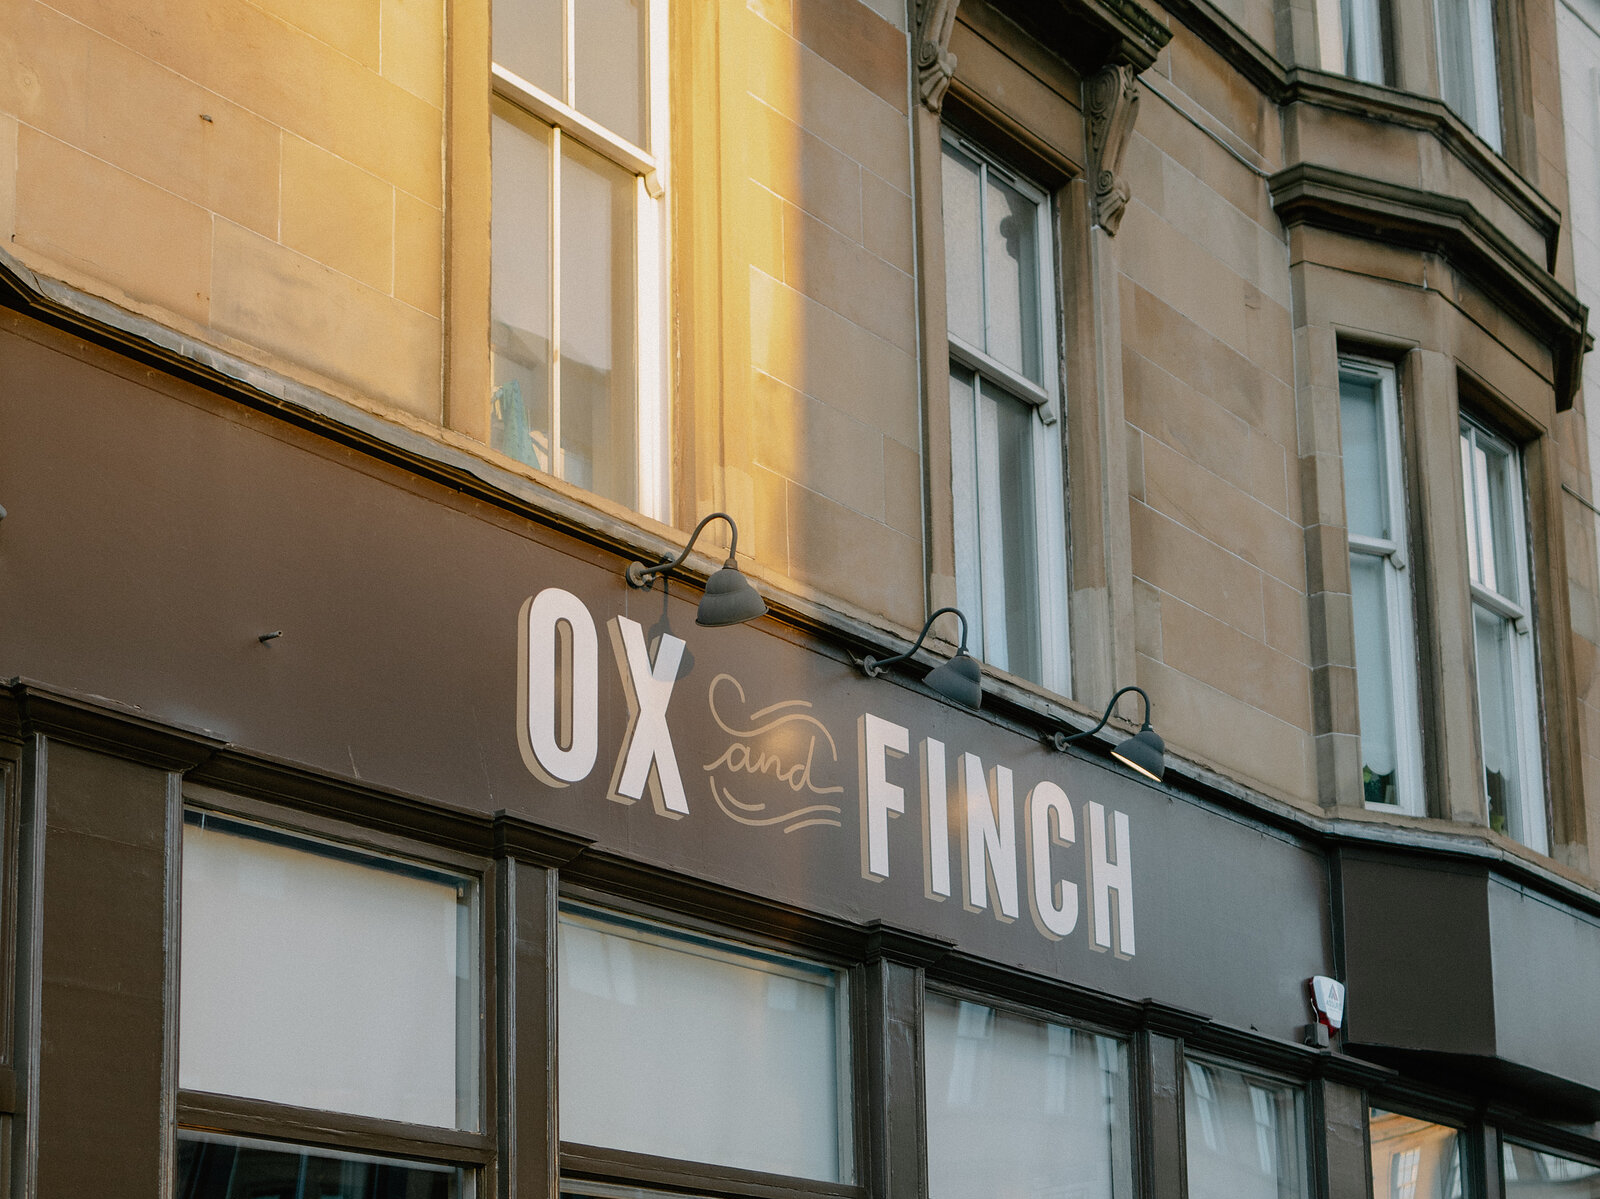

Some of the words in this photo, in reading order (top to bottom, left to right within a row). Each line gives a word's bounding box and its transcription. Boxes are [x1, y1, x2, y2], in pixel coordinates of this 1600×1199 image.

[516, 587, 690, 820] OX
[703, 735, 844, 795] and
[857, 713, 1136, 961] FINCH
